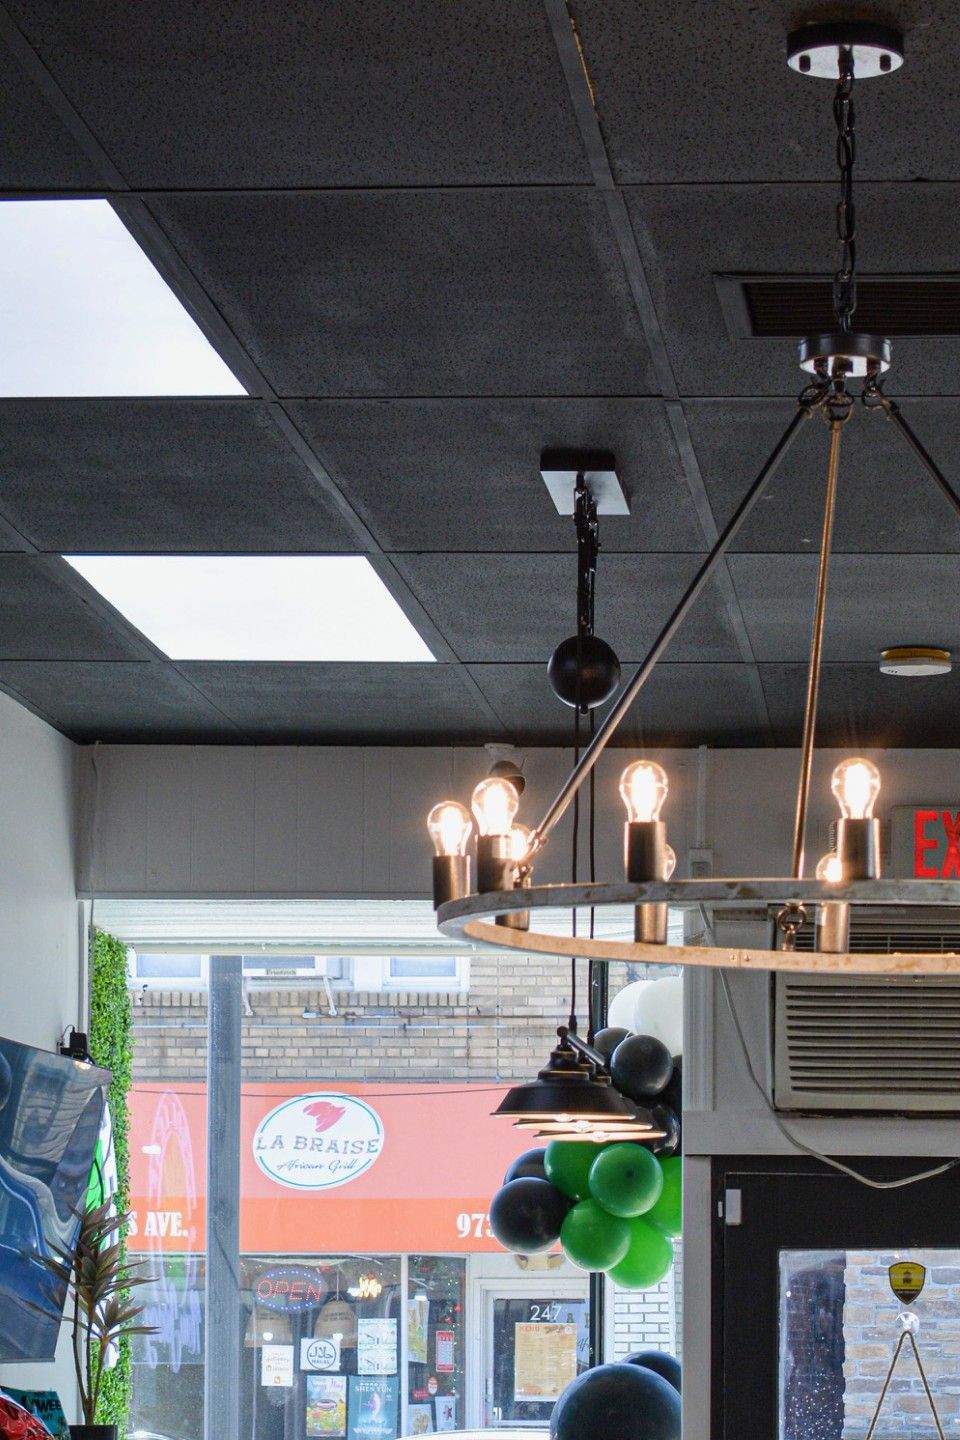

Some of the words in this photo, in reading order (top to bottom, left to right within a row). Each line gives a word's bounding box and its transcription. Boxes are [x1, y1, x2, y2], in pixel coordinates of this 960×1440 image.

[256, 1135, 285, 1151] LA
[293, 1136, 380, 1155] BRAISE
[328, 1158, 359, 1173] Grill
[144, 1211, 189, 1237] AVE.
[257, 1279, 323, 1302] OPEN
[530, 1305, 562, 1321] 247
